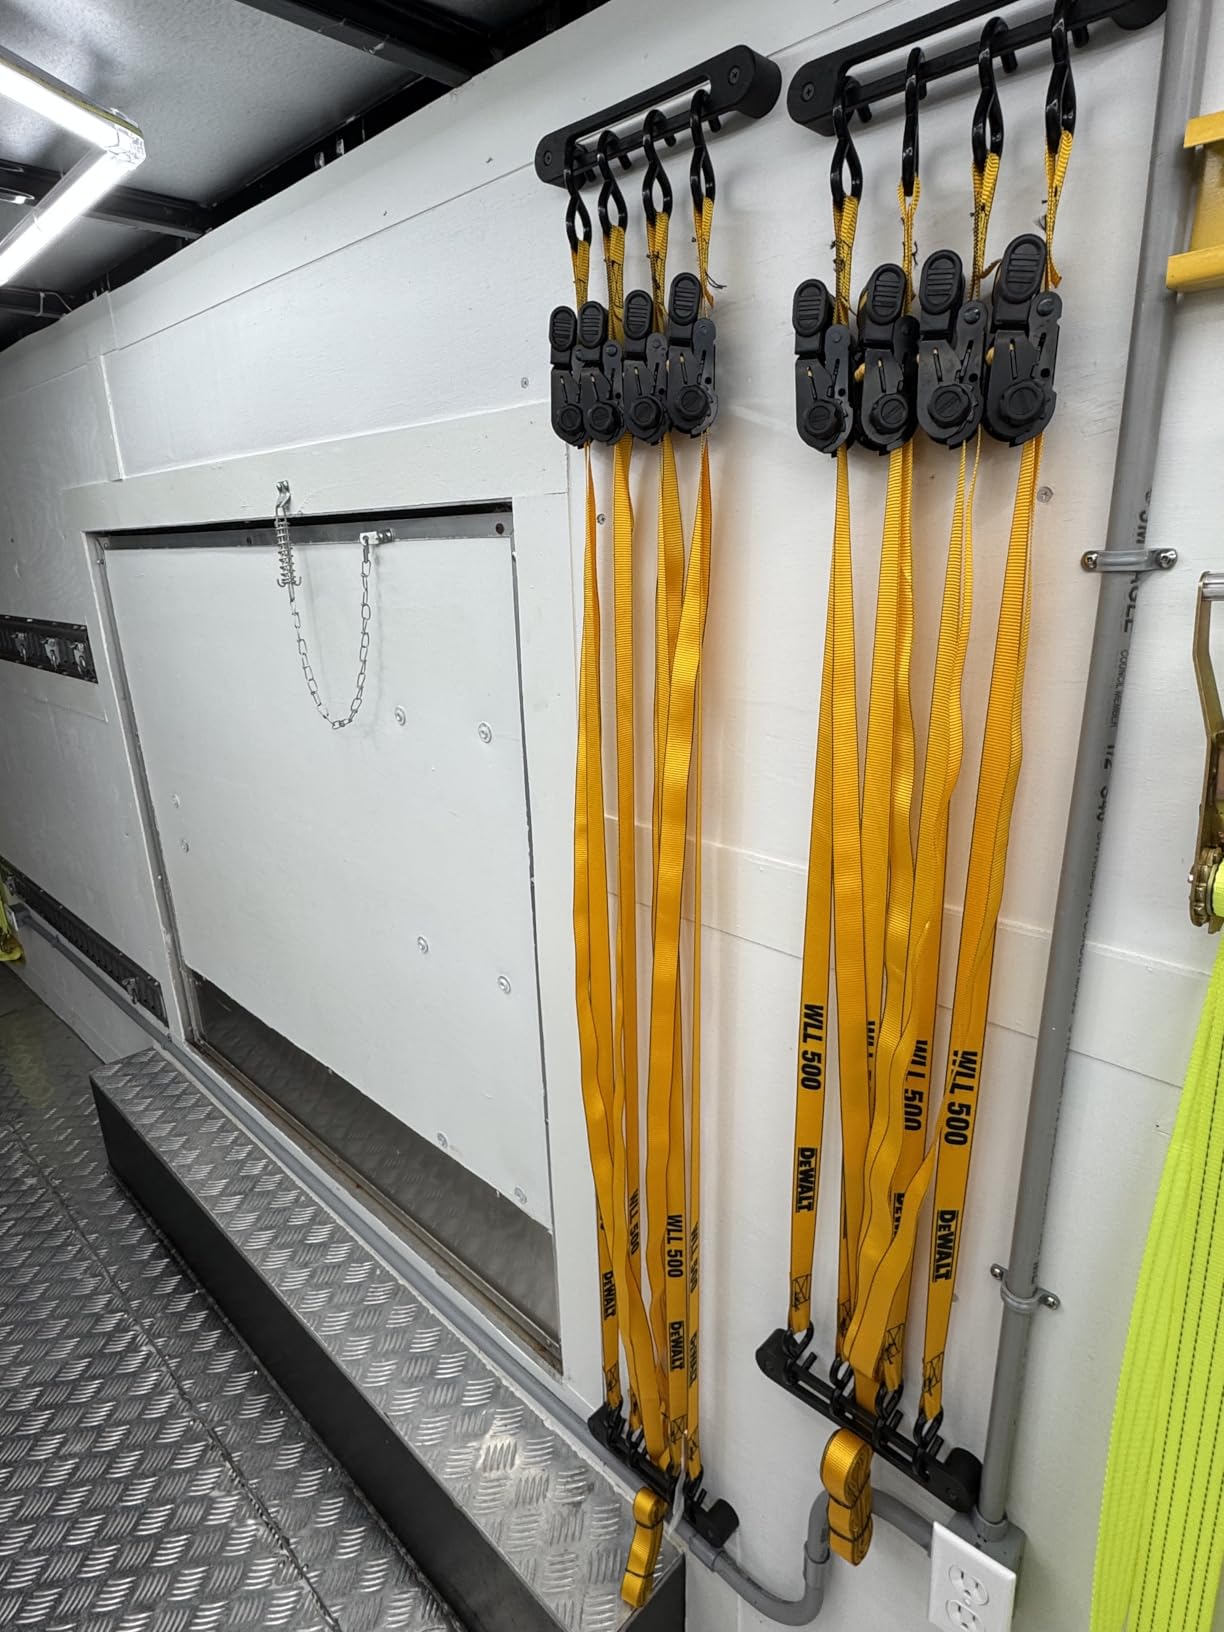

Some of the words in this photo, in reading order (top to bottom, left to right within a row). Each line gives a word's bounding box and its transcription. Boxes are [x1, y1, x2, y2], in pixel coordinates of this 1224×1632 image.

[802, 1003, 824, 1043] WLL
[801, 1050, 822, 1090] 500
[949, 1050, 978, 1094] WLL
[904, 1088, 924, 1131] 500
[944, 1101, 971, 1146] 500
[630, 1222, 640, 1256] 500
[667, 1214, 683, 1245] WLL
[667, 1249, 684, 1279] 500
